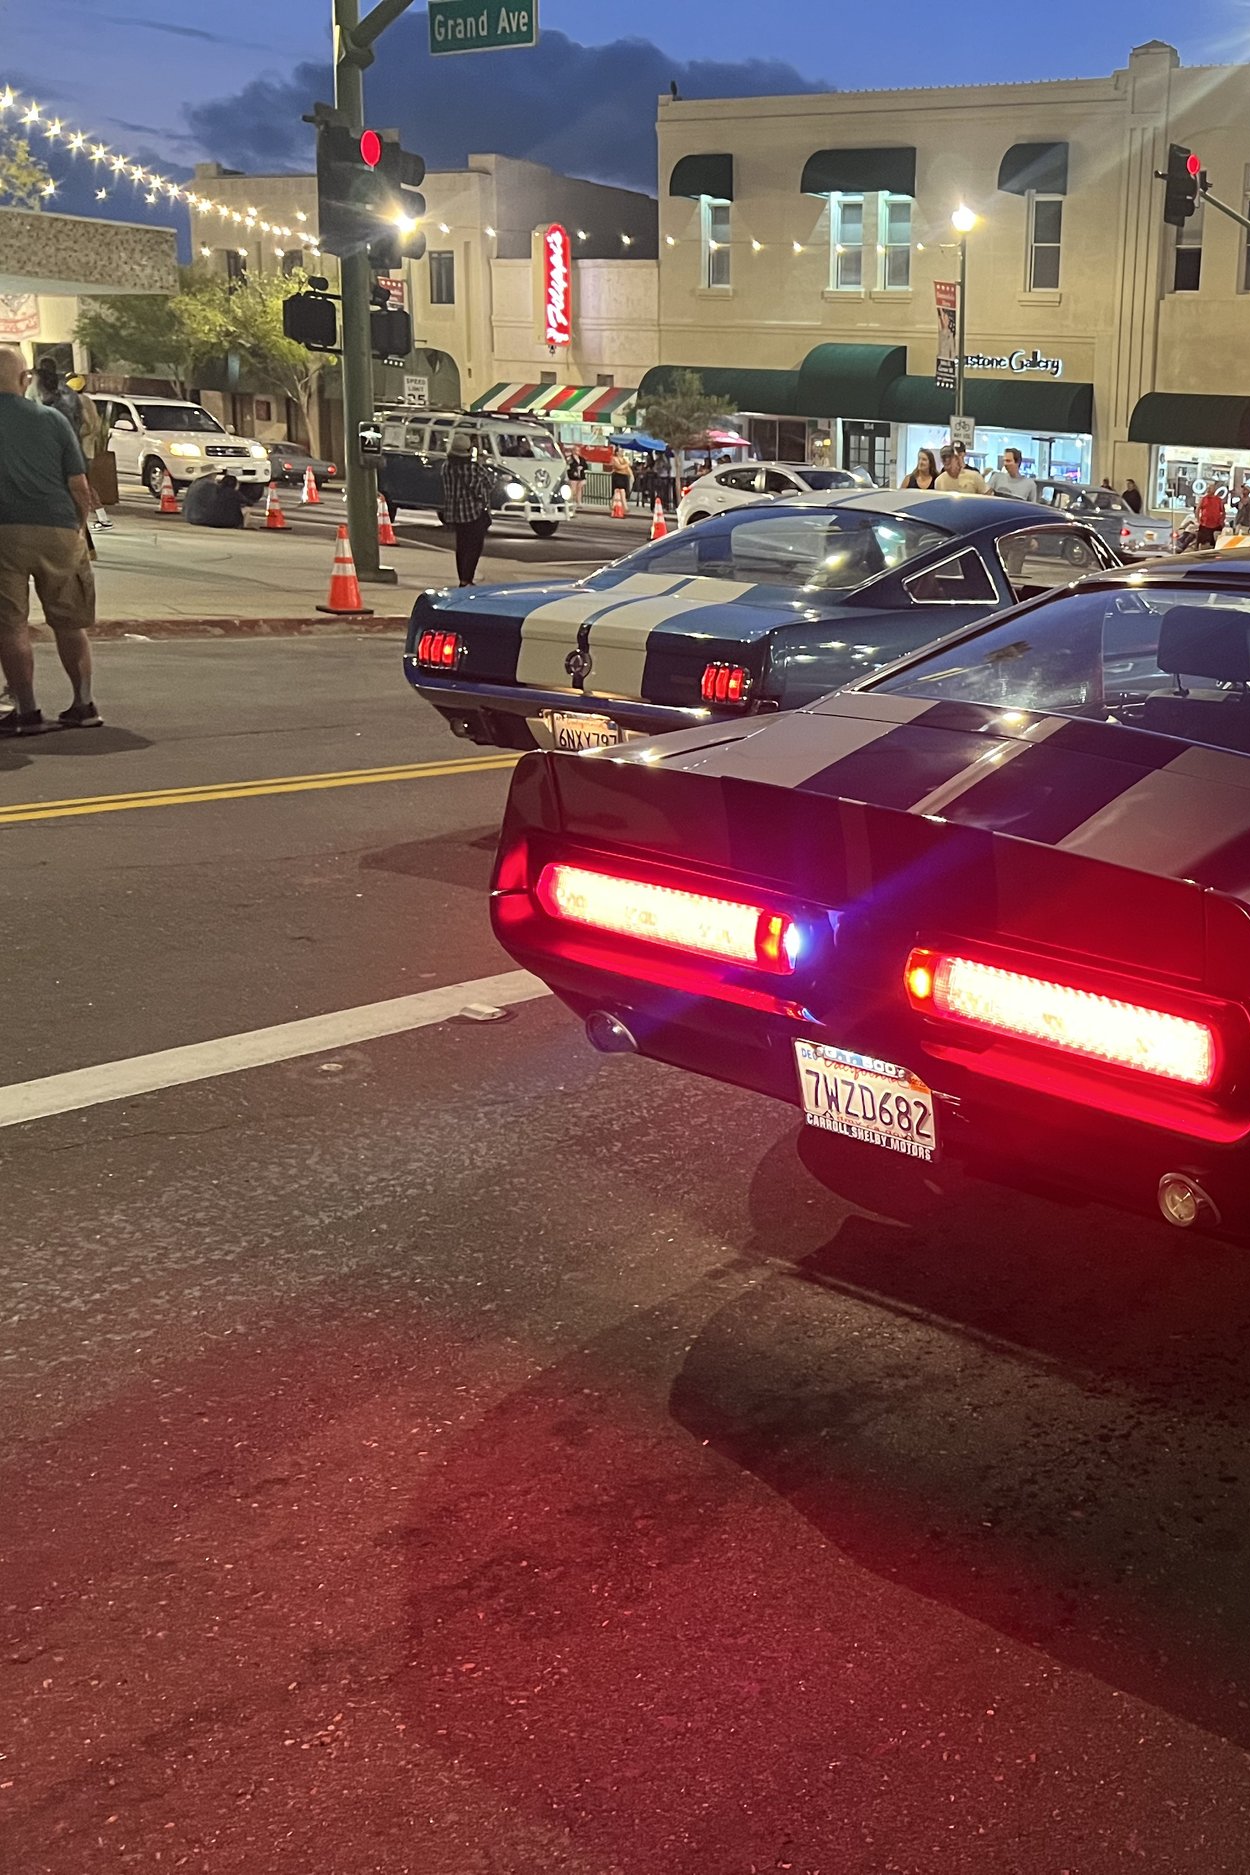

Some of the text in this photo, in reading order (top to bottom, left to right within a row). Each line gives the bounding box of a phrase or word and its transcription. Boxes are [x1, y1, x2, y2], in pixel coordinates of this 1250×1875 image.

[434, 7, 529, 41] Grand Ave
[1009, 349, 1062, 377] Gallery
[560, 728, 617, 749] 6NXY797
[805, 1069, 932, 1139] 7WZD682
[806, 1112, 932, 1161] CARROLL SHELBY MOTORS
